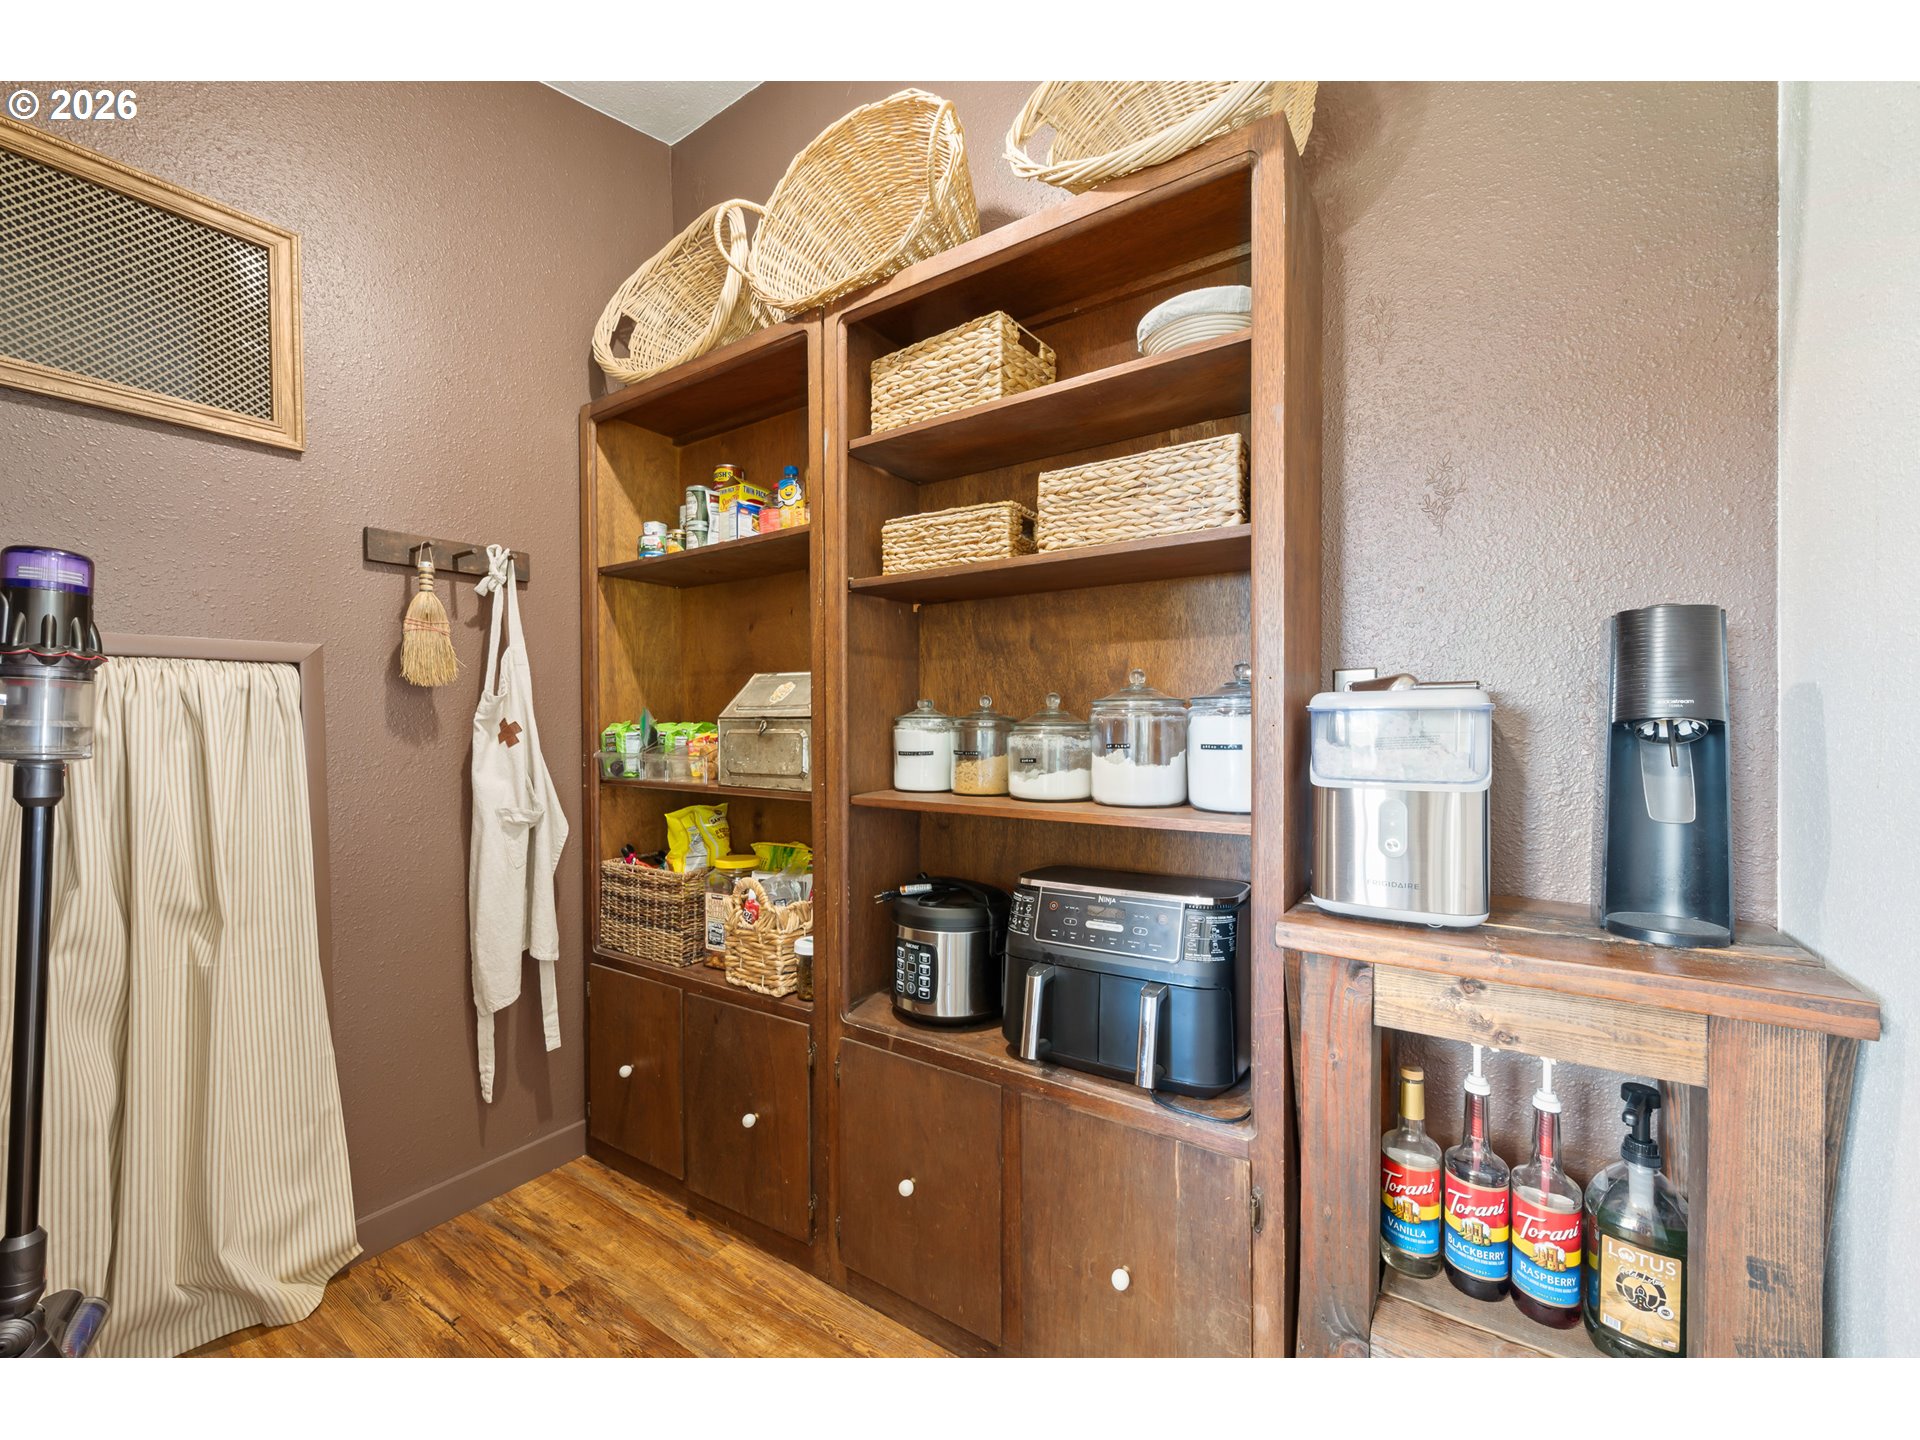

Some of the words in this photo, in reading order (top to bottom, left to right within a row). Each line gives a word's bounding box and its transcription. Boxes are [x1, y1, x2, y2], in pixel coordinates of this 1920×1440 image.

[1382, 1167, 1435, 1196] Torani
[1447, 1187, 1506, 1216] Torani
[1387, 1215, 1427, 1239] VANILLA
[1516, 1211, 1581, 1241] Torani
[1447, 1232, 1505, 1261] BLACKBERRY
[1608, 1240, 1676, 1277] LOTUS
[1520, 1260, 1577, 1287] RASPBERRY
